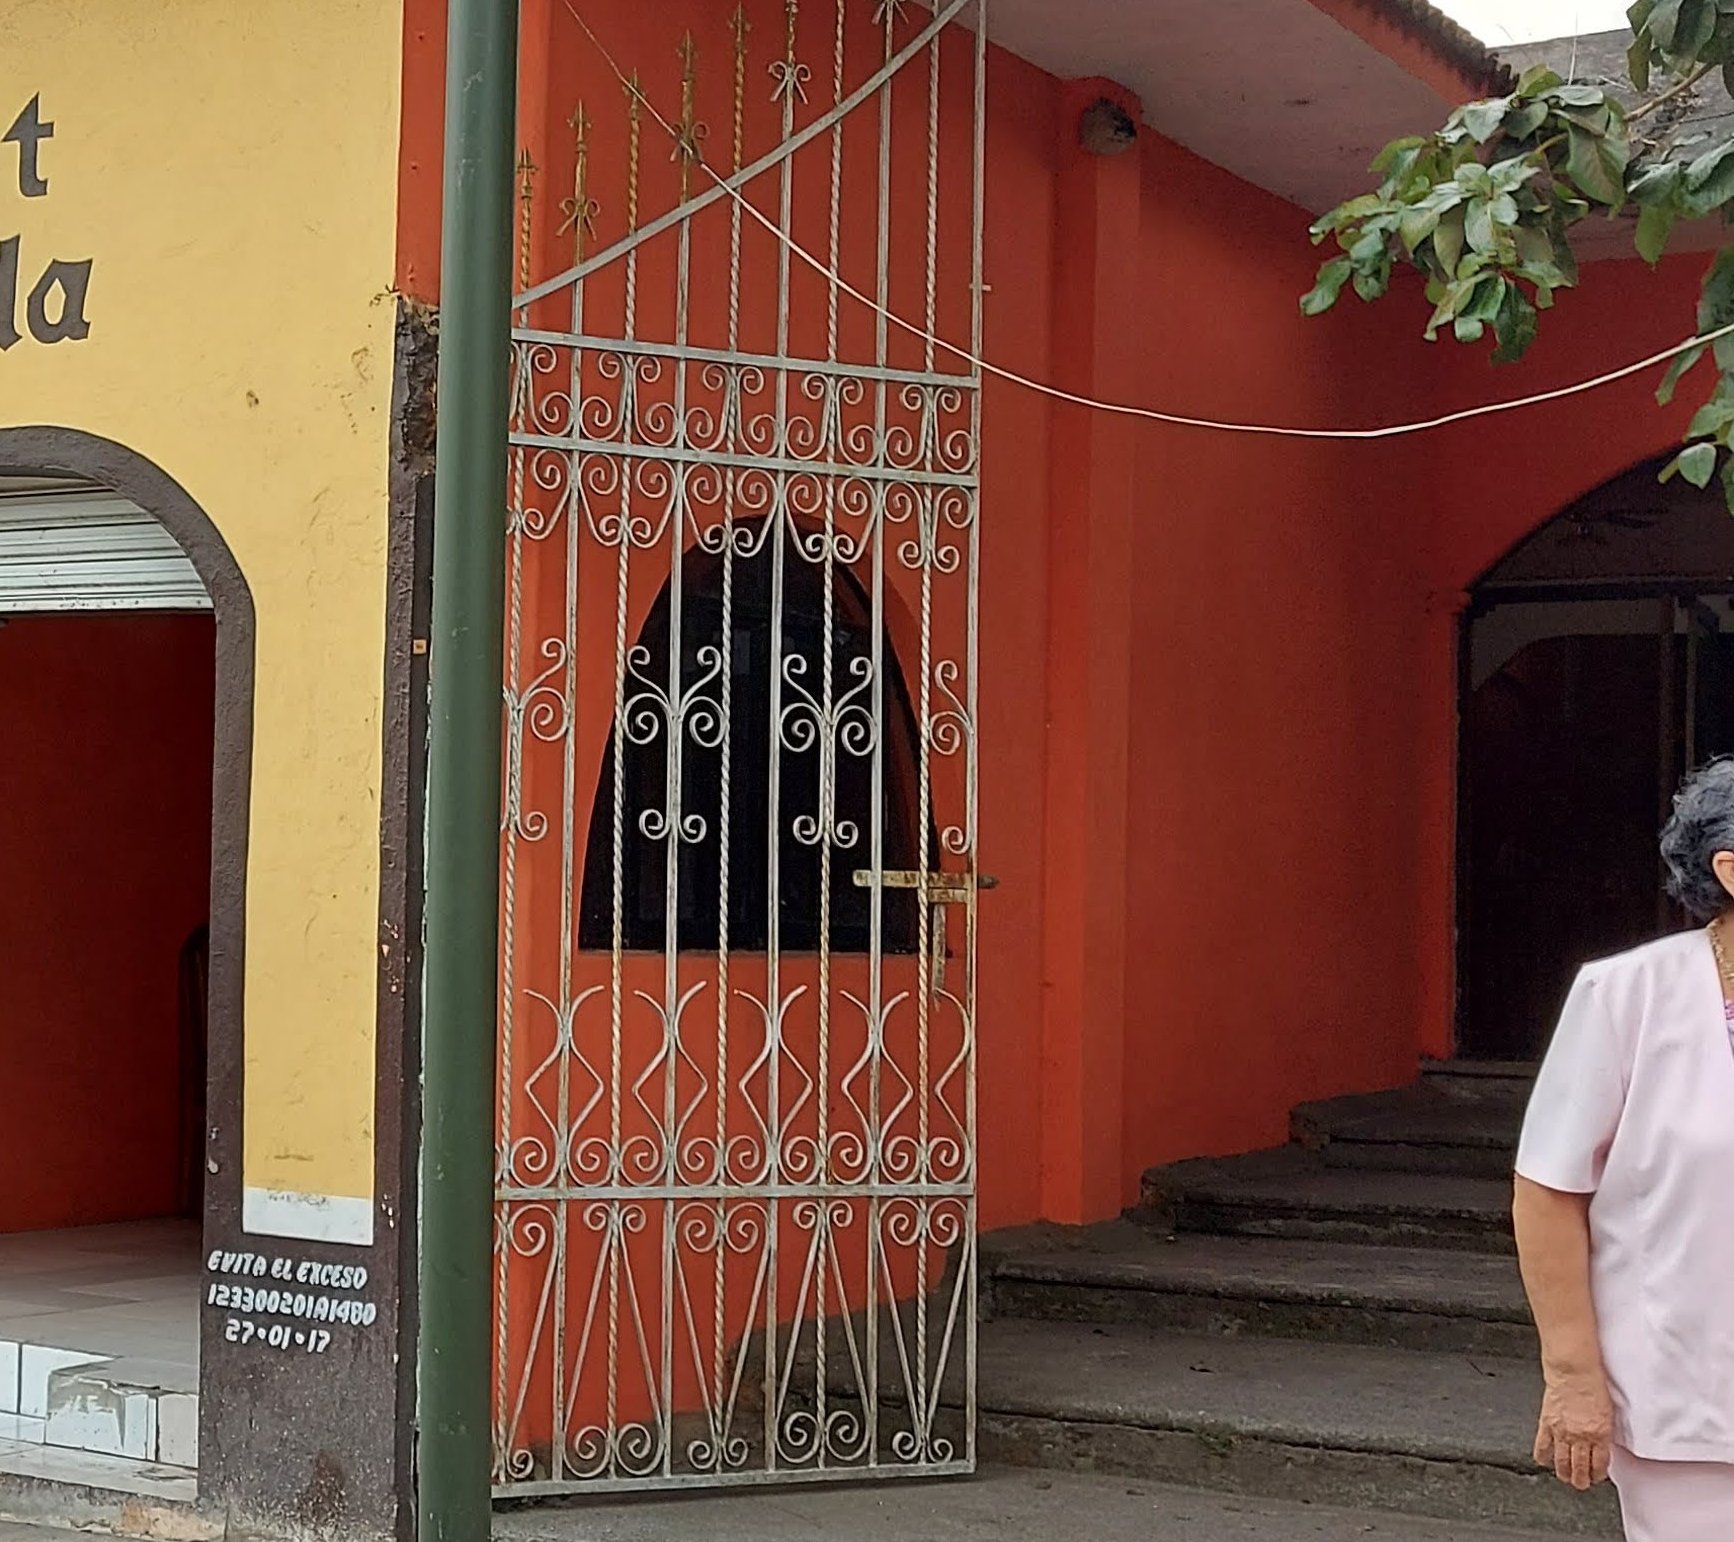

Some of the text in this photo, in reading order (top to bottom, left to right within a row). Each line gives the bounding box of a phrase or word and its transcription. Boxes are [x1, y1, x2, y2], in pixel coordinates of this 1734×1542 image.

[207, 1249, 369, 1291] EVITA EL EXCESO
